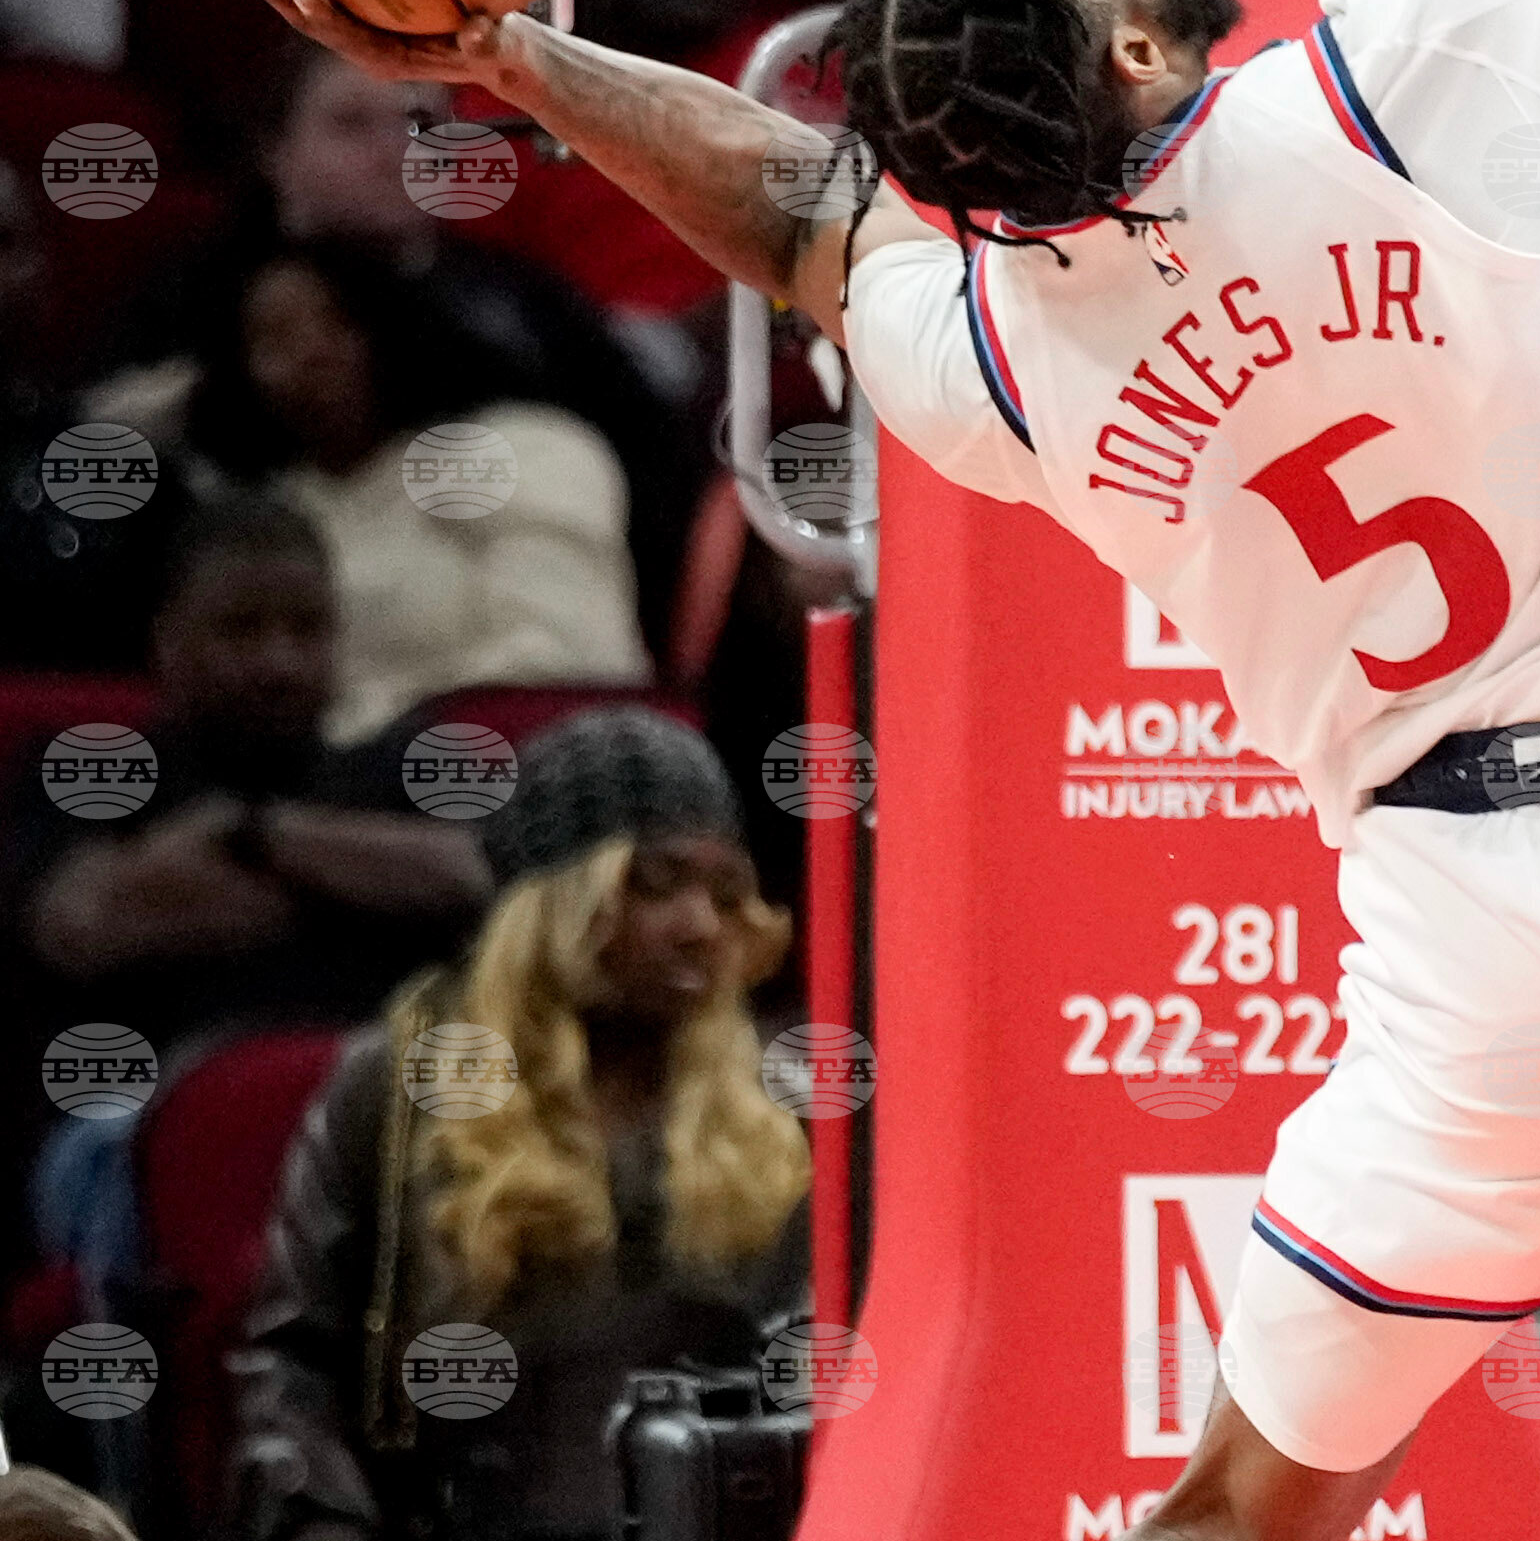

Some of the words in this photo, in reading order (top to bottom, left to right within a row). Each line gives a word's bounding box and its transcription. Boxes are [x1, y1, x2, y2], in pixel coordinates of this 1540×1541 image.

[1088, 275, 1293, 525] JONES
[1320, 240, 1447, 348] JR.
[1241, 411, 1512, 693] 5
[1060, 780, 1214, 821] INJURY
[1171, 902, 1301, 985] 281
[1060, 993, 1348, 1076] 222-22
